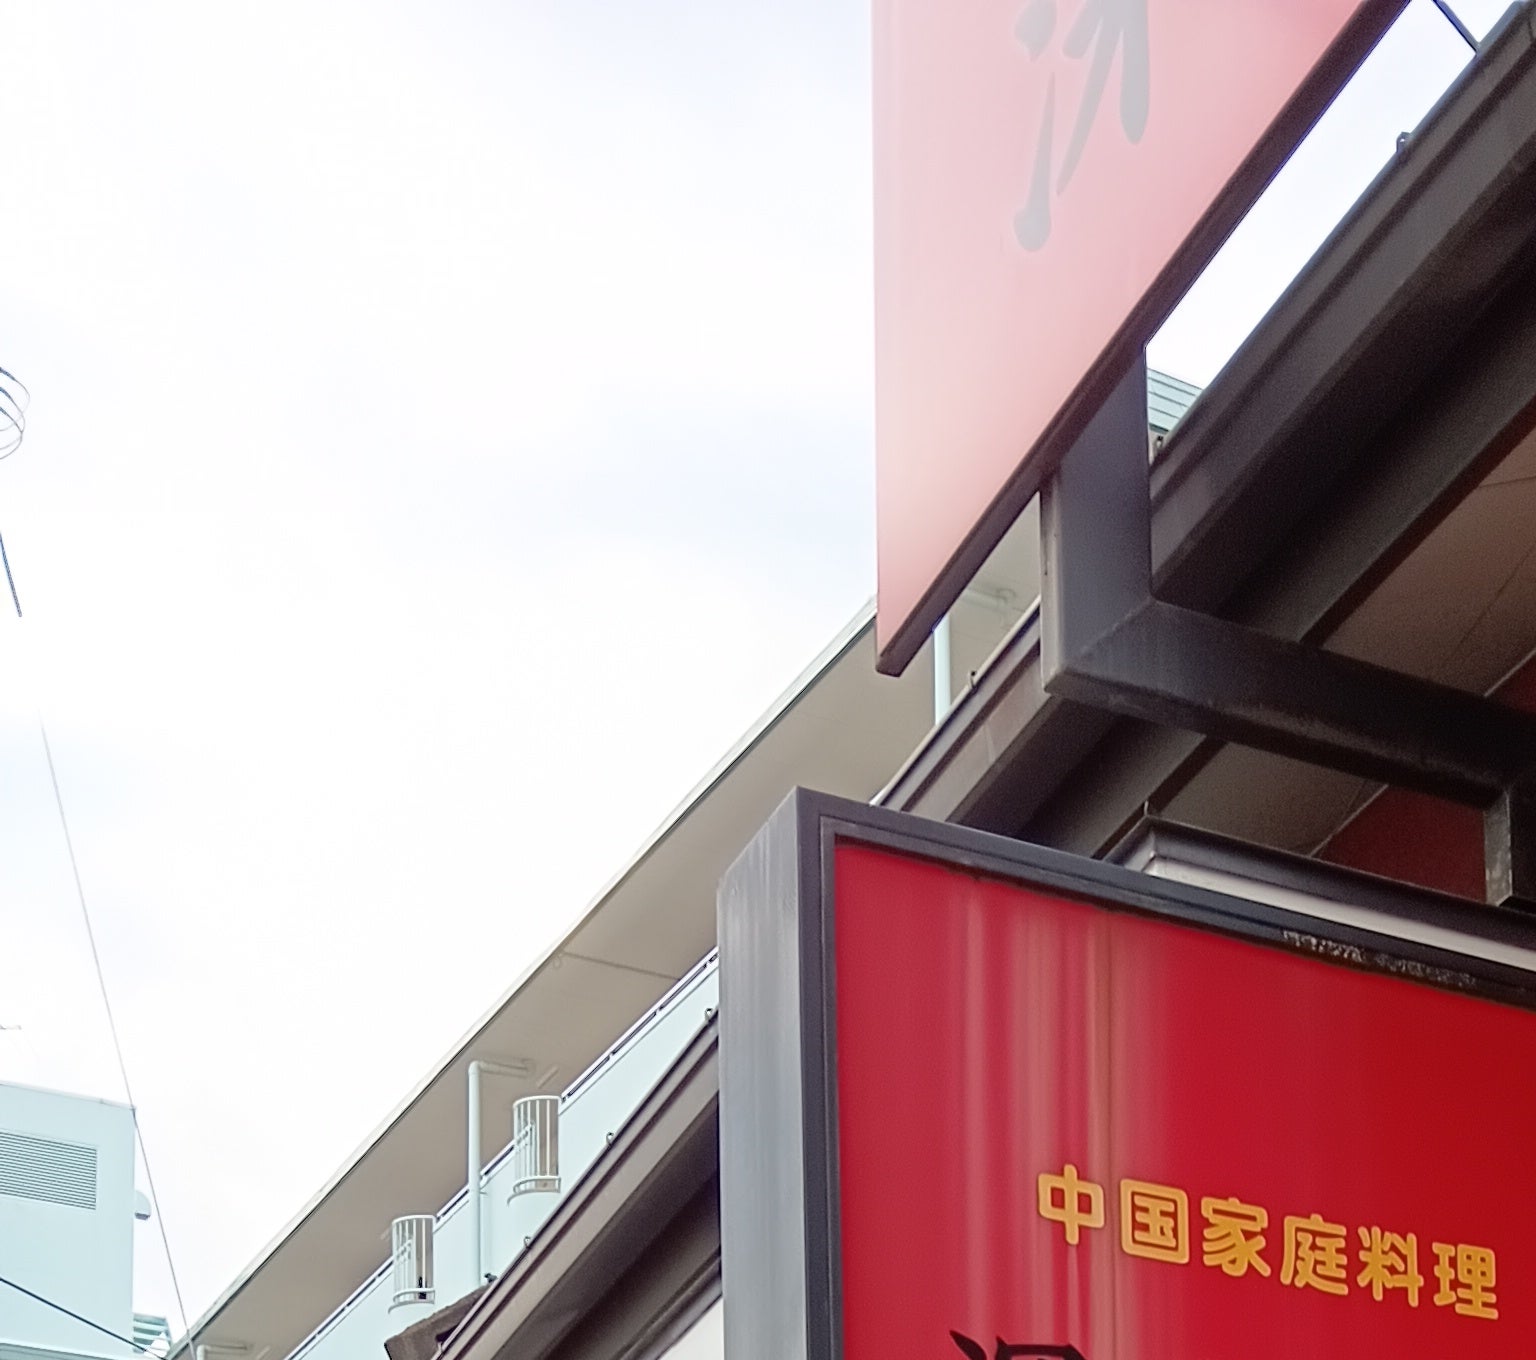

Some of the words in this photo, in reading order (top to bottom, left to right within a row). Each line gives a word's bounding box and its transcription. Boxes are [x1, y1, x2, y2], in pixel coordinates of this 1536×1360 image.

[1037, 1163, 1500, 1320] 中国家庭料理
